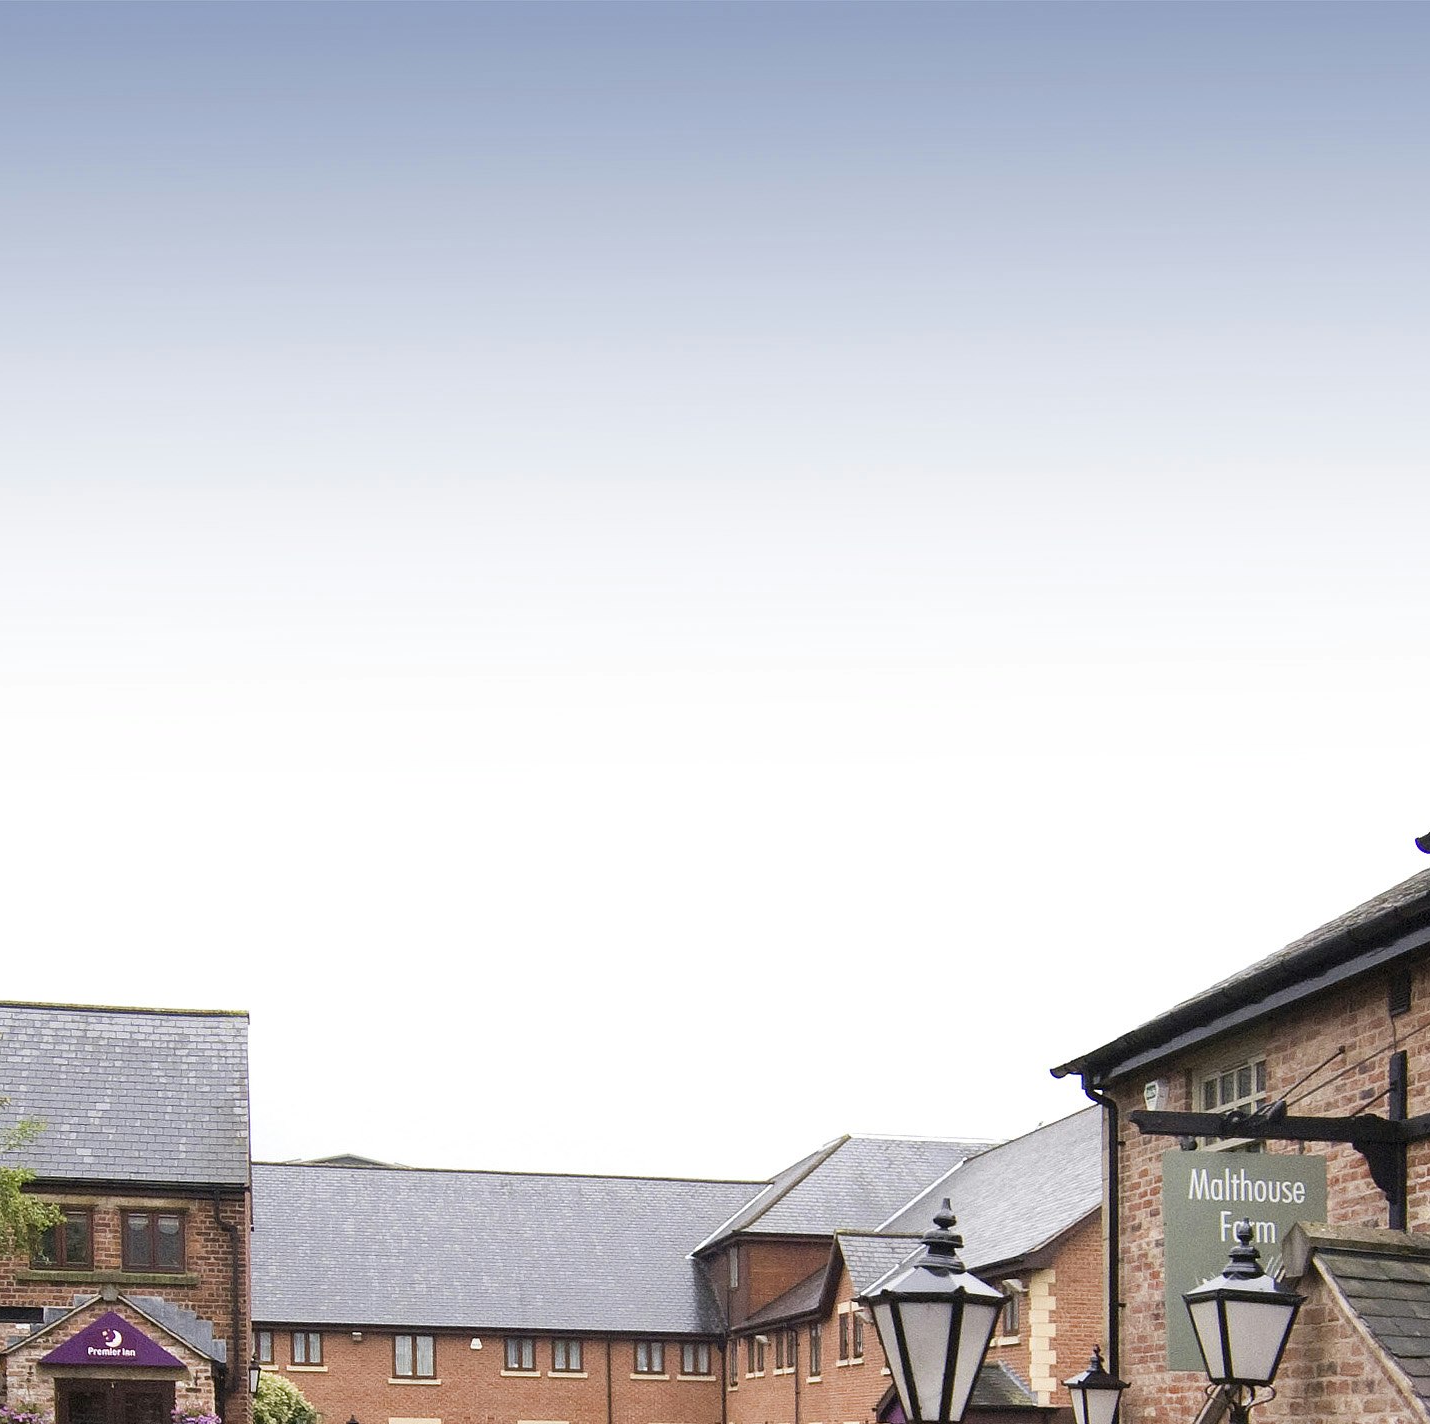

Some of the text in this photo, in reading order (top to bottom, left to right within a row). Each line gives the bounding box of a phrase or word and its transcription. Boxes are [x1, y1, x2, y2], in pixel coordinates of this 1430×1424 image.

[1188, 1168, 1306, 1203] Malthouse
[87, 1346, 136, 1357] Premier Inn
